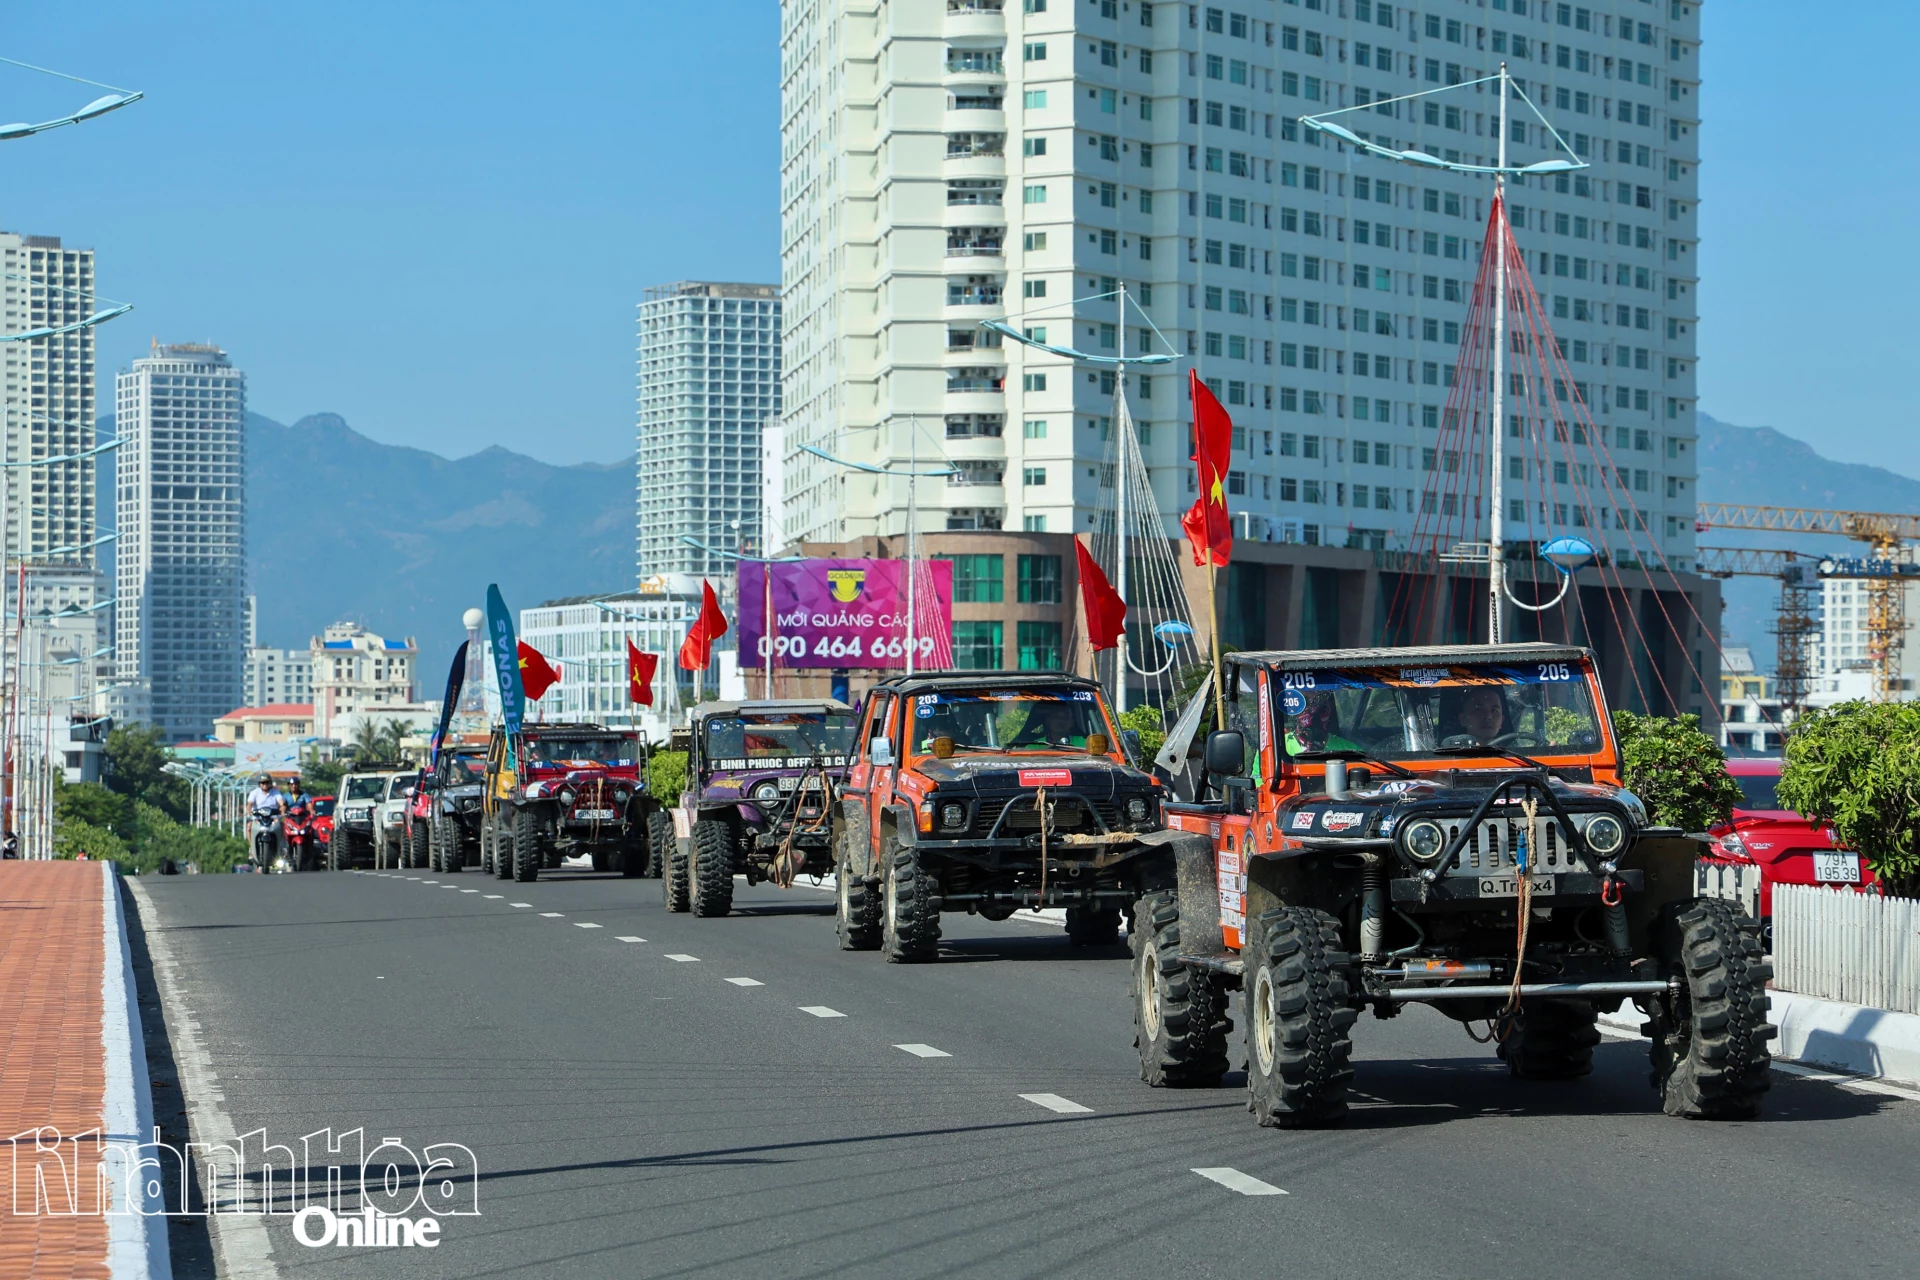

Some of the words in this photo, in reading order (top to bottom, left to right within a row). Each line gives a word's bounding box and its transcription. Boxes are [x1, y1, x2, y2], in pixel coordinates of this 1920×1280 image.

[777, 611, 808, 627] MỜI
[812, 610, 874, 627] QUẢNG
[757, 636, 806, 658] 090
[813, 636, 862, 659] 464
[870, 636, 935, 658] 6699
[1538, 663, 1570, 681] 205
[1284, 672, 1316, 689] 205
[918, 695, 938, 704] 203
[1073, 691, 1091, 701] 203
[1283, 697, 1300, 707] 205
[720, 759, 746, 770] BINH
[748, 759, 783, 769] PHUOC
[1824, 853, 1848, 866] 79A
[1818, 867, 1858, 880] 195.39
